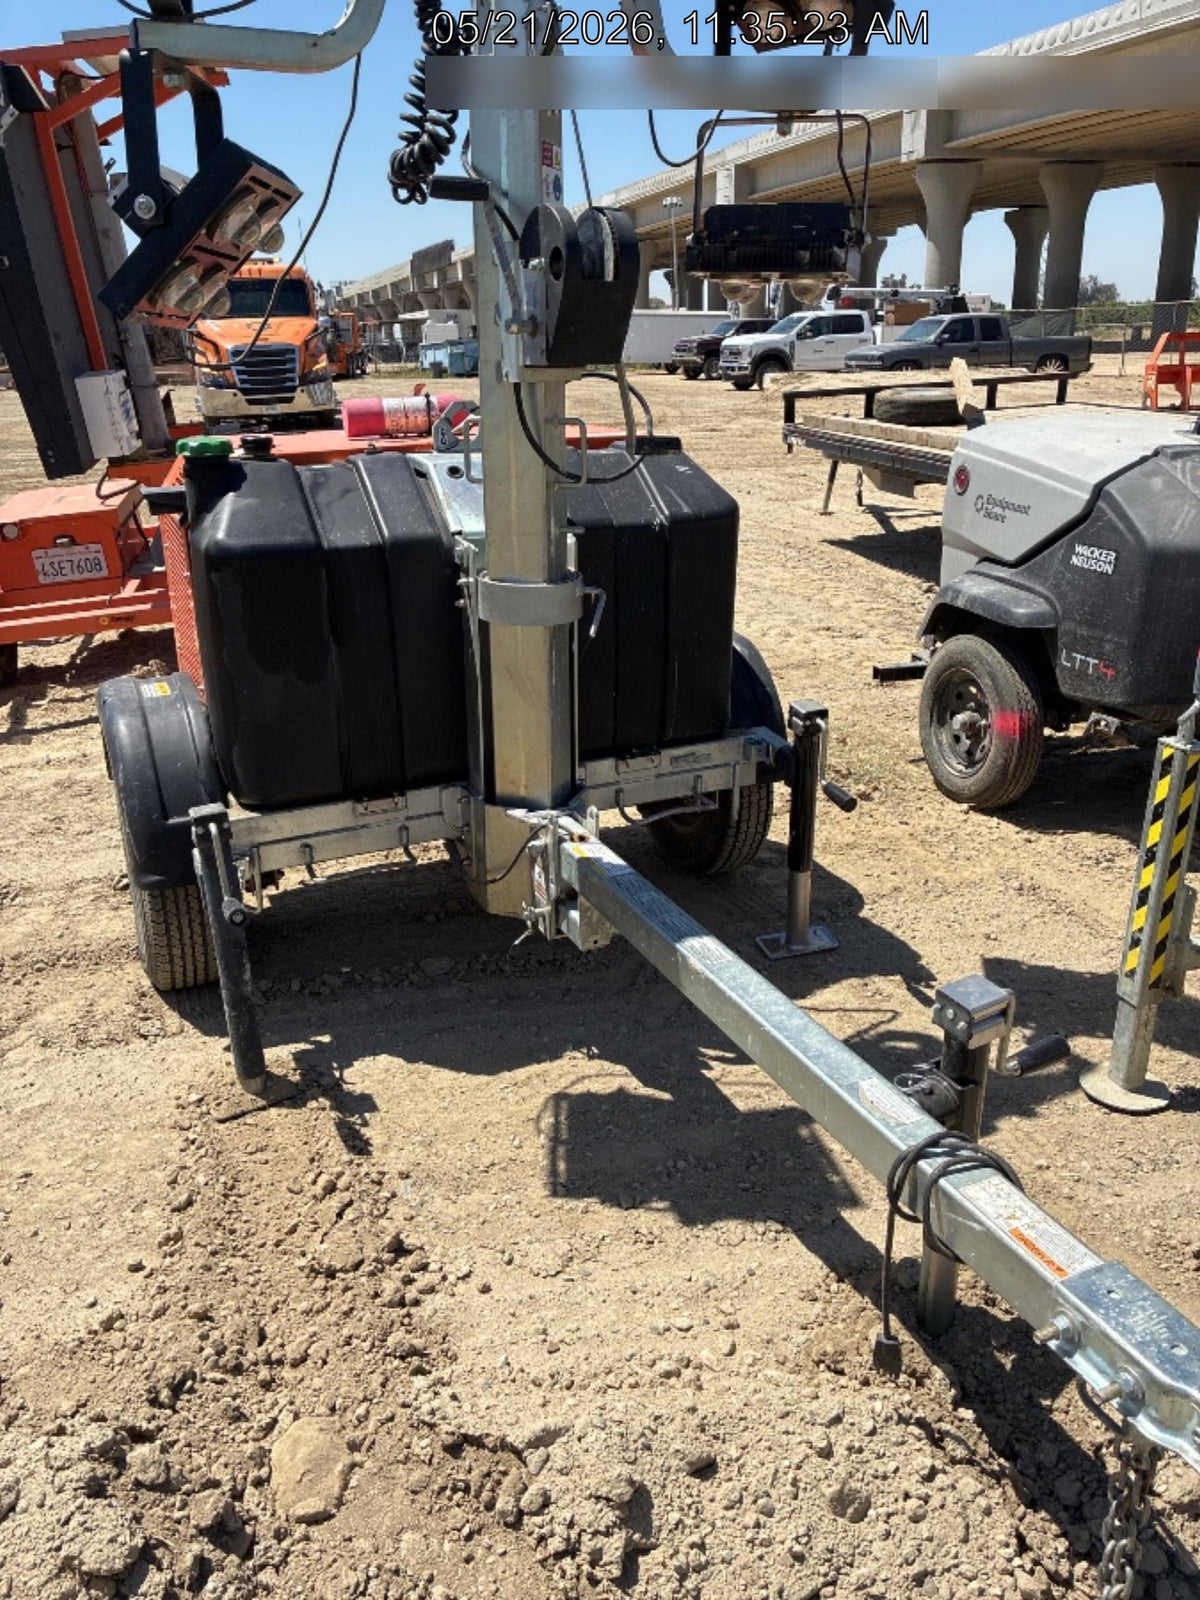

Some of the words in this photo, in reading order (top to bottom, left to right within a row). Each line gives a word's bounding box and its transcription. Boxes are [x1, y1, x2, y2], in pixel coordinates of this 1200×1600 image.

[1075, 543, 1116, 563] WACKER
[1069, 554, 1115, 575] NEUSON
[1061, 648, 1116, 681] LTT4
